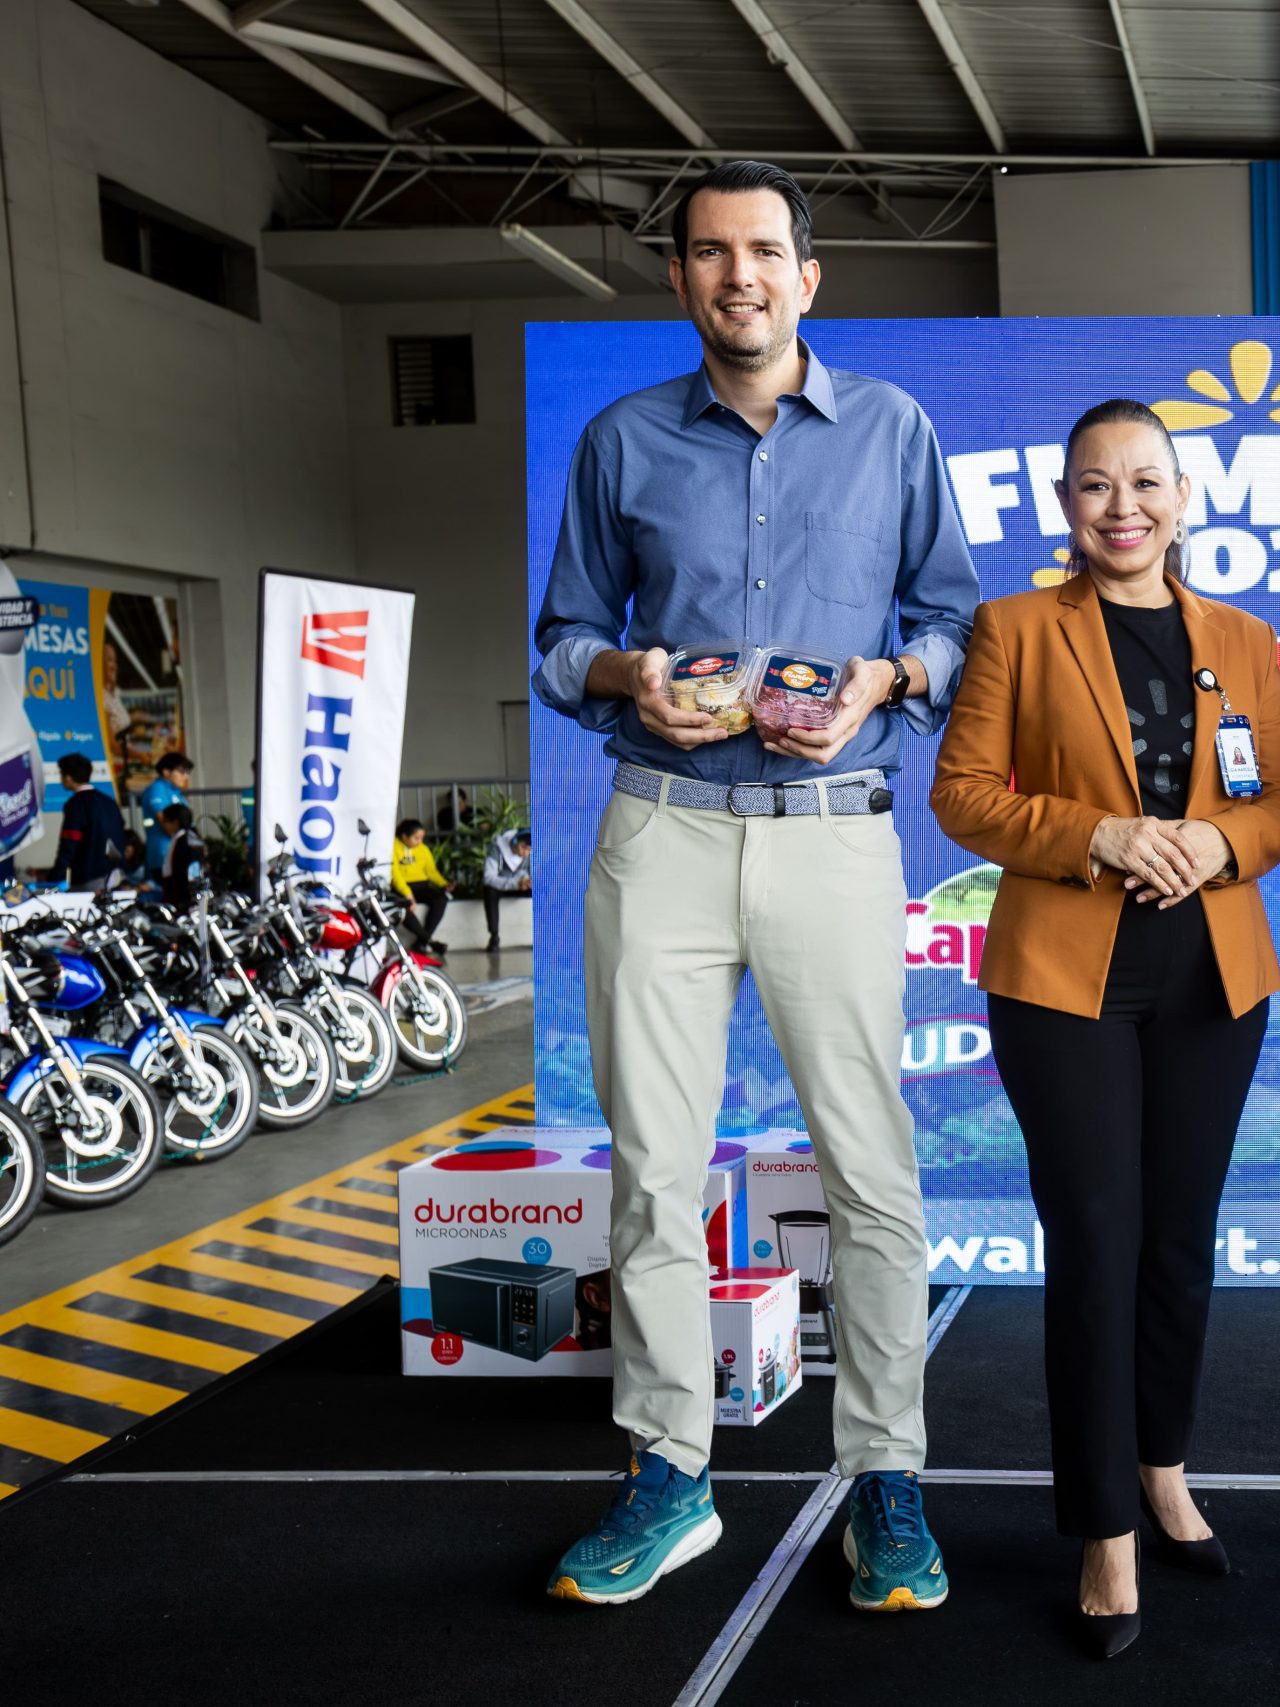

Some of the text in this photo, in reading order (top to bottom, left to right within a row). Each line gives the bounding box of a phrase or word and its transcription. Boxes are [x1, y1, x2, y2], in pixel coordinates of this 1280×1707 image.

[24, 659, 77, 701] QUÍ
[414, 1198, 583, 1224] durabrand
[415, 1228, 507, 1239] MICROONDAS
[528, 1242, 547, 1255] 30
[440, 1338, 454, 1350] 1.1
